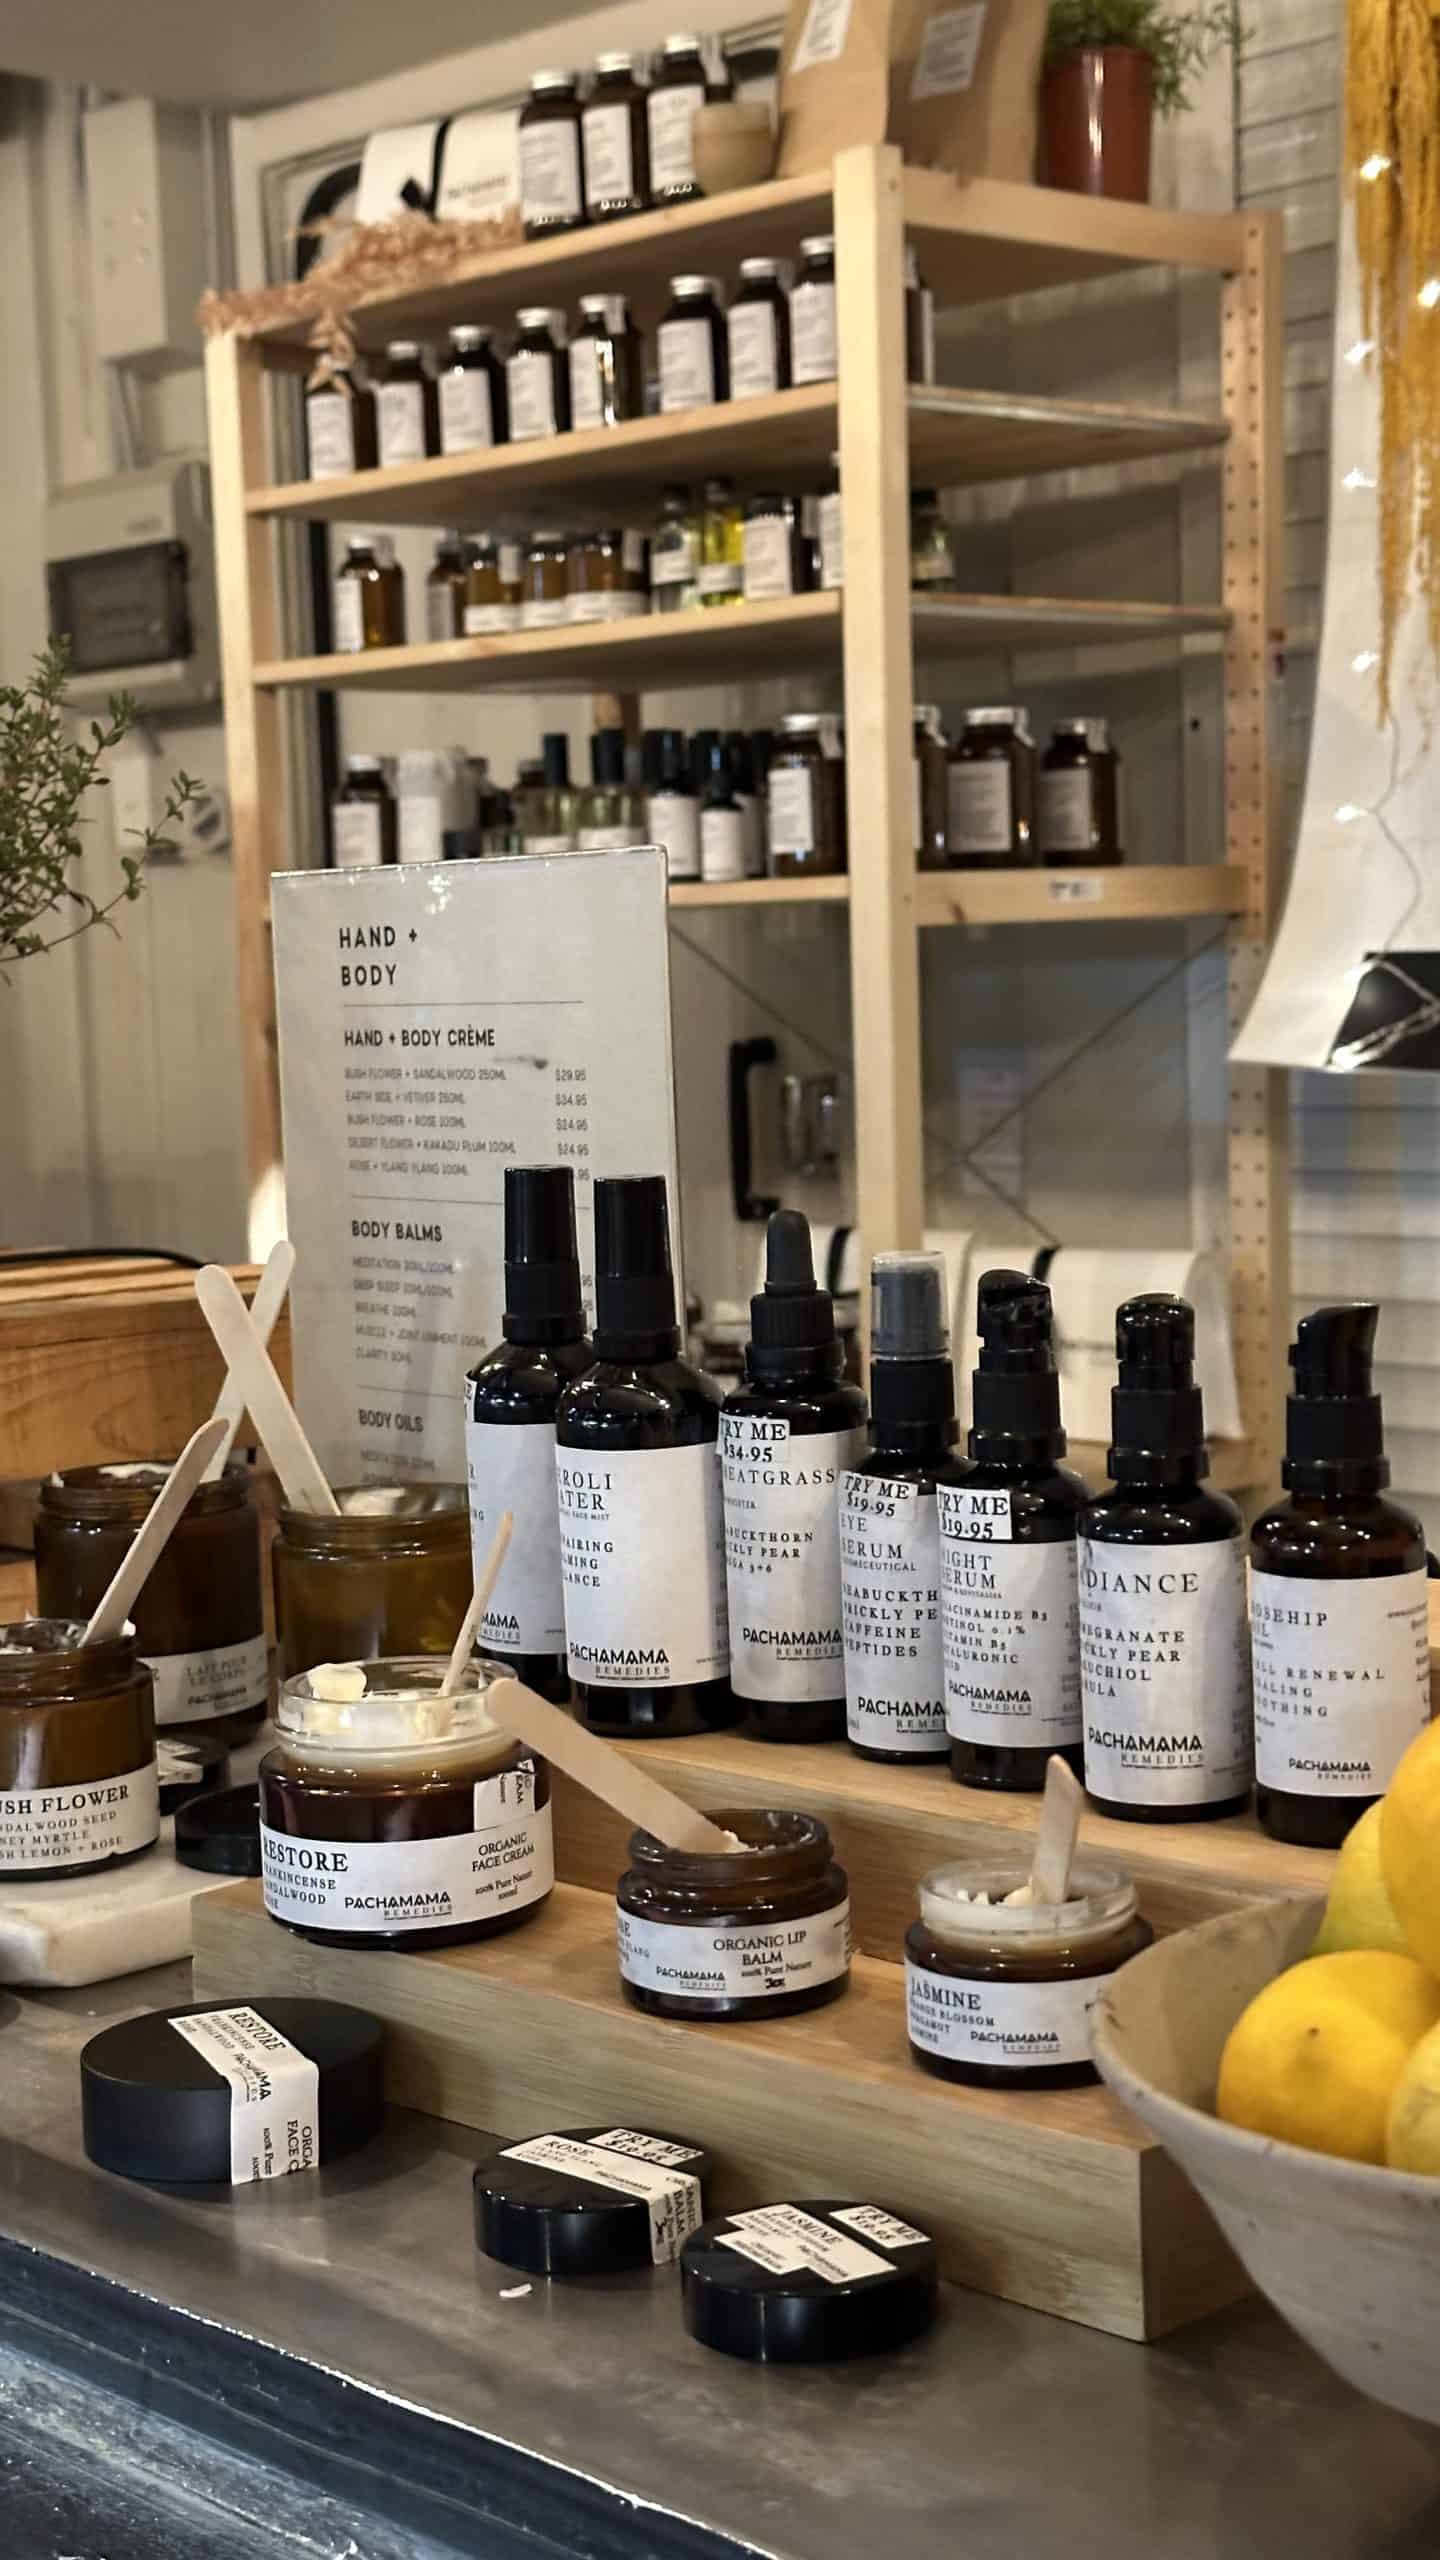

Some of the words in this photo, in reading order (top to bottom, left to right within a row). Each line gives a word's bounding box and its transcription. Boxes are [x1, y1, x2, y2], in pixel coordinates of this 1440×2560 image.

[339, 925, 397, 949] HAND
[408, 928, 418, 943] +
[340, 963, 397, 986] BODY
[344, 1028, 383, 1046] HAND
[401, 1029, 441, 1046] BODY
[448, 1024, 495, 1047] CRÈME
[413, 1067, 476, 1081] SANDALWOOD
[352, 1220, 389, 1239] BODY
[396, 1223, 443, 1243] BALMS
[357, 1408, 392, 1430] BODY
[394, 1413, 425, 1433] OILS
[720, 1417, 744, 1439] TRY
[751, 1423, 786, 1442] ME
[558, 1468, 613, 1491] ROLI
[844, 1475, 874, 1494] TRY
[878, 1481, 910, 1500] ME
[971, 1496, 1009, 1516] ME
[564, 1554, 599, 1570] MING
[761, 1547, 801, 1559] PEAR
[943, 1548, 993, 1571] IGHT
[564, 1573, 601, 1588] ANCE
[1081, 1567, 1200, 1594] DIANCE
[1253, 1601, 1328, 1627] OSEHIP
[742, 1627, 843, 1646] PACHAMAMA
[569, 1641, 669, 1665] PACHAMAMA
[1128, 1650, 1181, 1663] PEAR
[1286, 1667, 1385, 1681] RENEWAL
[948, 1679, 1032, 1703] PACHAMAMA
[1088, 1727, 1203, 1752] PACHAMAMA
[1288, 1758, 1371, 1773] PACHAMAMA
[41, 1784, 130, 1813] FLOWER
[32, 1830, 89, 1846] MYRTLE
[477, 1831, 527, 1856] ORGANIC
[263, 1835, 349, 1872] RESTORE
[471, 1856, 501, 1873] FACE
[502, 1844, 535, 1867] CREAM
[344, 1891, 451, 1909] PACHAMAMA
[712, 1934, 785, 1952] ORGANIC
[787, 1929, 807, 1945] LIP
[742, 1951, 784, 1966] BALM
[656, 1965, 726, 1982] PACHAMAMA
[911, 1975, 982, 2011] JASMINE
[228, 2011, 287, 2051] RESTORE
[970, 2031, 1059, 2043] PACHAMAMA
[287, 2119, 300, 2155] FACE
[545, 2140, 594, 2157] ROSE
[659, 2144, 697, 2160] ME
